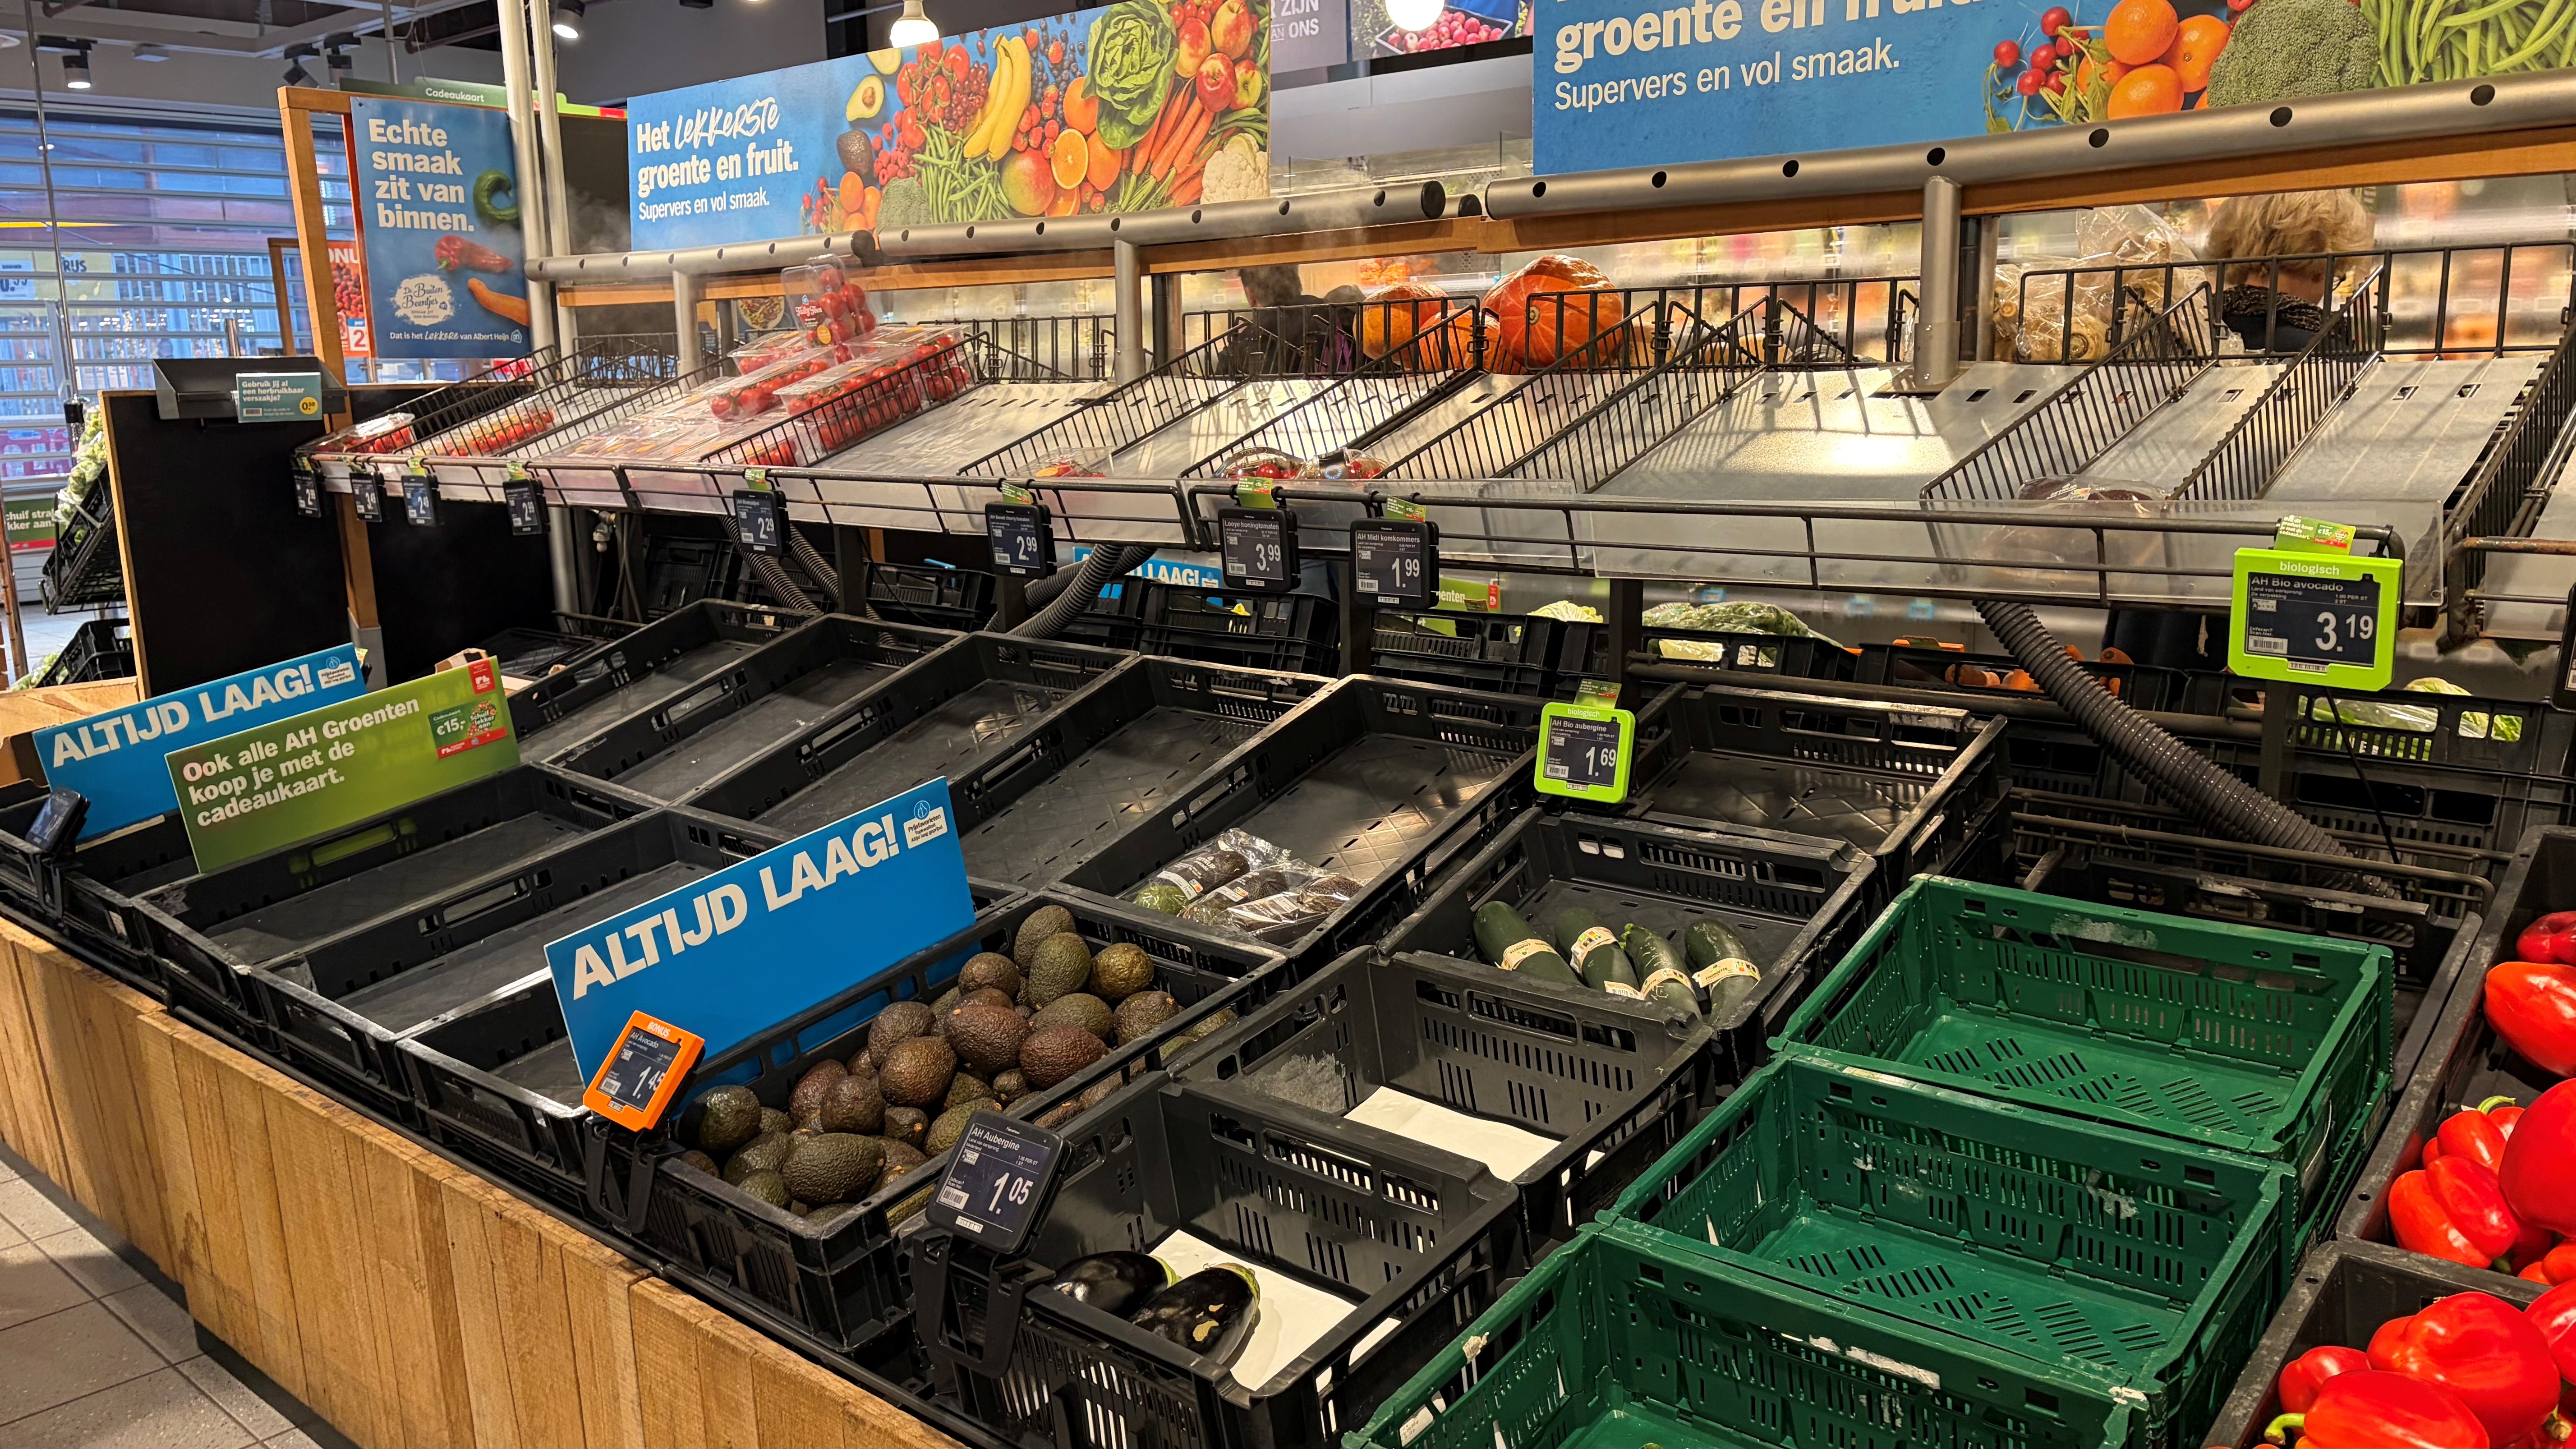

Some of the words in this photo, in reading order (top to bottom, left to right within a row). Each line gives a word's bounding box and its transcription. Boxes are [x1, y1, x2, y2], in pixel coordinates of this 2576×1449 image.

[1271, 28, 1284, 39] AN
[1289, 18, 1319, 38] ONS
[1554, 0, 1743, 74] groente
[1554, 70, 1686, 113] Supervers
[1697, 63, 1729, 93] en
[1740, 51, 1780, 87] vol
[1792, 37, 1900, 81] smaak.
[426, 88, 484, 102] Cadeaukaart
[368, 119, 447, 147] Echte
[637, 120, 670, 153] Het
[372, 150, 463, 175] smaak
[638, 155, 711, 198] groente
[717, 153, 741, 180] en
[747, 139, 799, 176] fruit.
[375, 175, 411, 200] zit
[417, 183, 465, 203] van
[639, 198, 691, 223] Supervers
[695, 195, 708, 214] en
[711, 191, 727, 211] vol
[730, 187, 769, 210] smaak.
[377, 203, 474, 231] binnen.
[402, 295, 438, 309] Beentjes
[413, 283, 443, 298] Buiten
[494, 333, 509, 341] Heijn
[5, 510, 29, 521] chuif
[32, 508, 54, 520] stra
[7, 521, 30, 530] kker
[1225, 520, 1240, 529] Looye
[1241, 521, 1279, 530] honingtomaten
[758, 517, 775, 539] 2.29
[1381, 535, 1420, 543] komkommers
[1017, 535, 1037, 561] 2.99
[1256, 543, 1281, 571] 3.99
[1148, 563, 1199, 586] LAAG!
[1392, 558, 1420, 588] 1.99
[2280, 561, 2339, 575] biologisch
[2251, 577, 2268, 585] AH
[2272, 578, 2291, 587] Bio
[2294, 581, 2344, 592] avocado
[1439, 590, 1465, 603] enten
[2315, 612, 2374, 652] 3.19
[53, 701, 190, 768] ALTIJD
[198, 664, 314, 722] LAAG!
[470, 710, 490, 721] Schuif
[474, 716, 494, 725] lekker
[1568, 707, 1600, 718] biologisch
[437, 718, 465, 735] €15,-
[1575, 722, 1607, 732] aubergine
[183, 754, 233, 782] Ook
[239, 741, 278, 766] alle
[285, 727, 317, 752] AH
[322, 699, 419, 739] Groenten
[188, 775, 247, 805] koop
[252, 766, 274, 790] je
[280, 749, 323, 777] met
[328, 741, 355, 761] de
[1586, 746, 1616, 777] 1.69
[197, 768, 345, 826] cadeaukaart.
[908, 814, 941, 833] Prijsfavorieten
[573, 883, 748, 1000] ALTIJD
[759, 814, 900, 912] LAAG!
[630, 1031, 639, 1040] AH
[638, 1035, 659, 1049] Avocado
[647, 1021, 671, 1037] BONUS
[633, 1066, 667, 1099] 1.45
[971, 1127, 984, 1138] AH
[983, 1132, 1020, 1150] Aubergine
[989, 1172, 1034, 1214] 1.05
